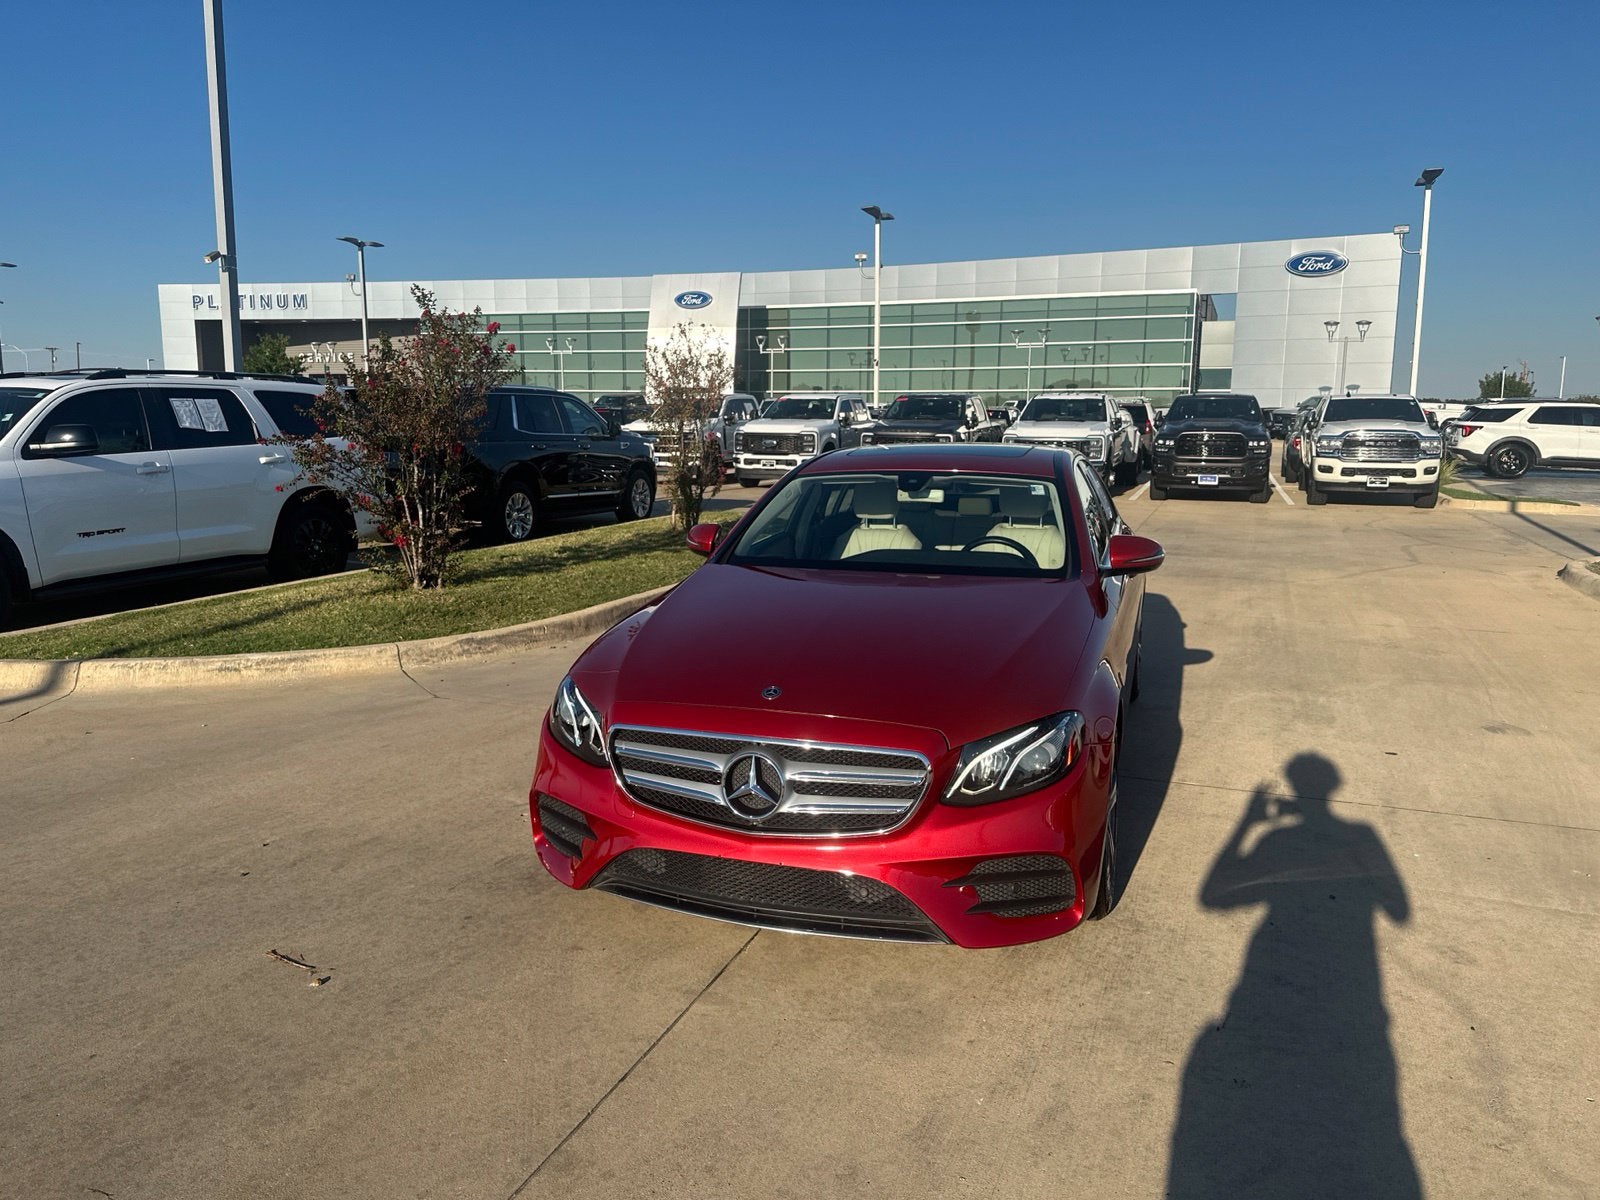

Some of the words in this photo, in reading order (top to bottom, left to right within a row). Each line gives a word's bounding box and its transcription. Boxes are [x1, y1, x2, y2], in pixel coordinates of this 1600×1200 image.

[1298, 256, 1333, 271] Ford
[681, 294, 703, 305] Ford
[96, 527, 126, 535] SPORT
